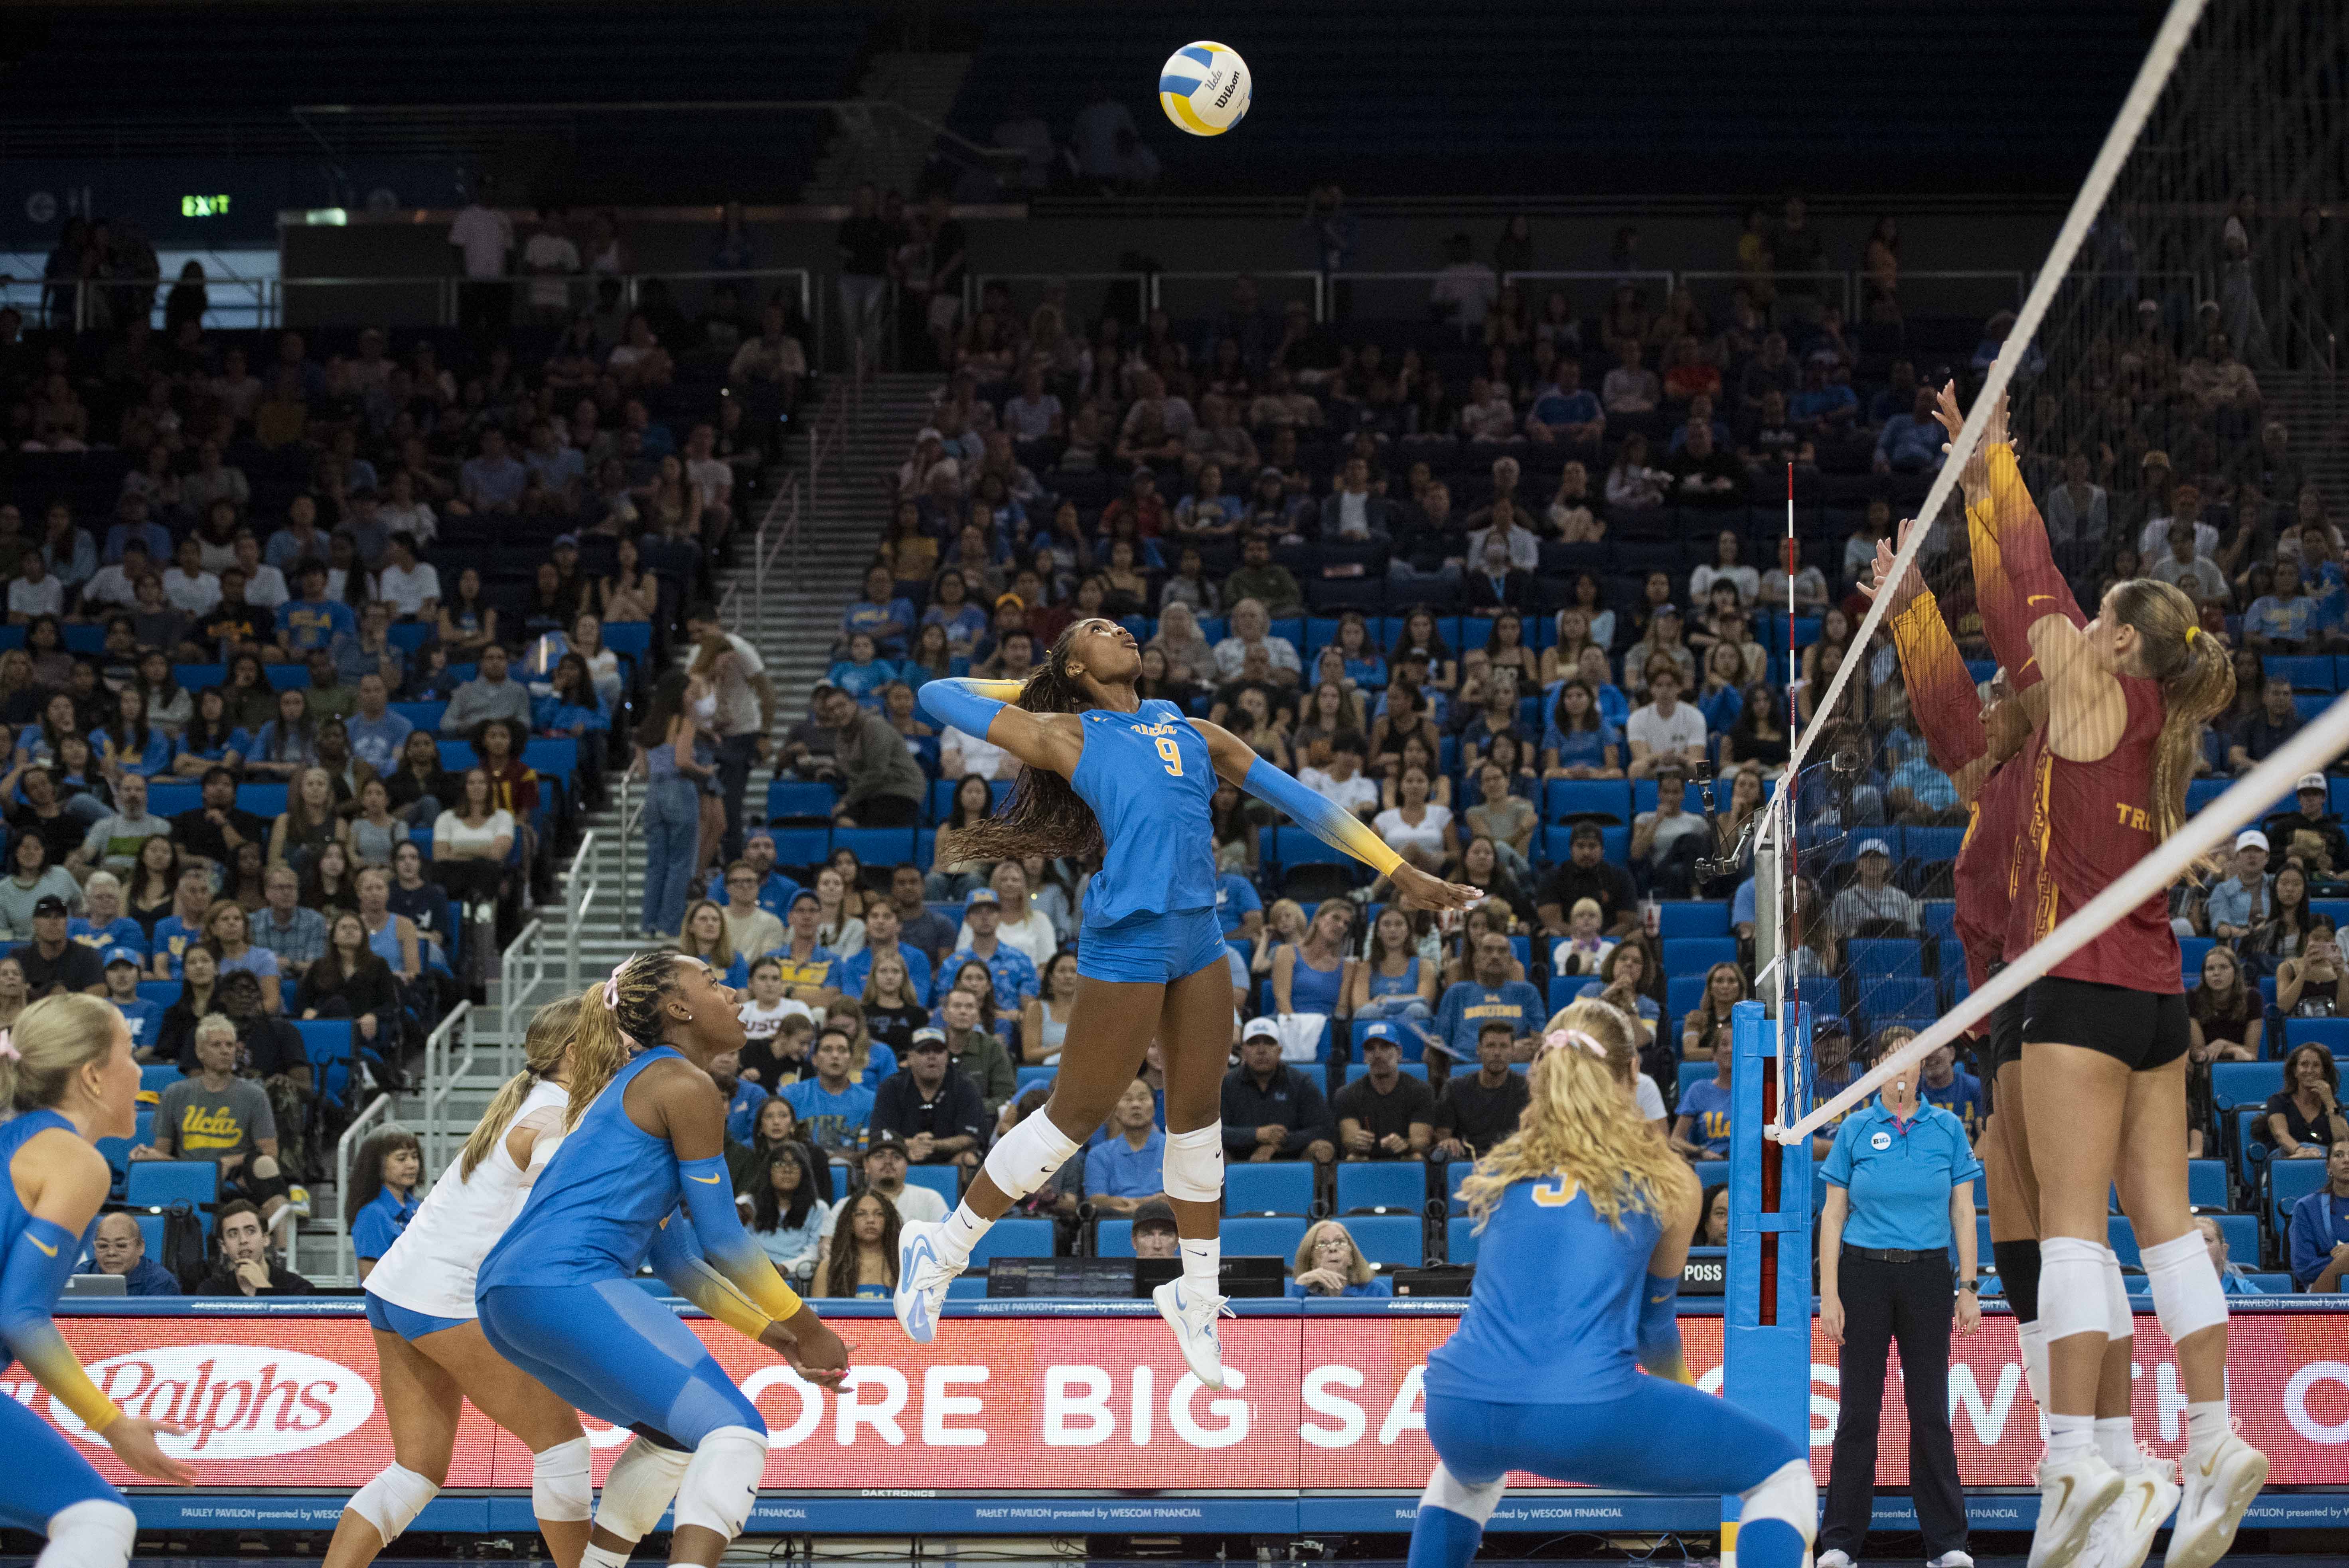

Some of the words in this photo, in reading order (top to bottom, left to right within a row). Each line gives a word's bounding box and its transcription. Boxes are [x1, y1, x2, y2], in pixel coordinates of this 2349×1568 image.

[1205, 69, 1223, 91] Ucla
[1214, 71, 1240, 108] Wilson
[182, 194, 230, 217] EXIT
[1155, 738, 1184, 776] 9
[2116, 802, 2150, 832] TR
[182, 1105, 243, 1135] Ucla
[1685, 1264, 1722, 1281] POSS
[1012, 1303, 1052, 1311] PAVILION
[2239, 1299, 2278, 1307] PAVILION
[2282, 1298, 2322, 1308] presented
[2325, 1298, 2336, 1309] by
[101, 1359, 338, 1451] Ralphs
[1044, 1365, 1250, 1448] BIG
[182, 1508, 213, 1517] PAULEY
[215, 1508, 255, 1518] PAVILION
[257, 1509, 298, 1520] presented
[300, 1509, 311, 1521] by
[758, 1508, 806, 1518] FINANCIAL
[976, 1509, 1009, 1518] PAULEY
[1011, 1509, 1052, 1517] PAVILION
[1053, 1508, 1095, 1519] presented
[1097, 1508, 1108, 1520] by
[1110, 1508, 1151, 1517] WESCOM
[1154, 1508, 1202, 1517] FINANCIAL
[1518, 1509, 1529, 1521] by
[1530, 1509, 1572, 1518] WESCOM
[1575, 1508, 1623, 1517] FINANCIAL
[1971, 1509, 2018, 1518] FINANCIAL
[2244, 1508, 2284, 1517] PAVILION
[2286, 1507, 2327, 1519] presented
[2331, 1507, 2341, 1519] by
